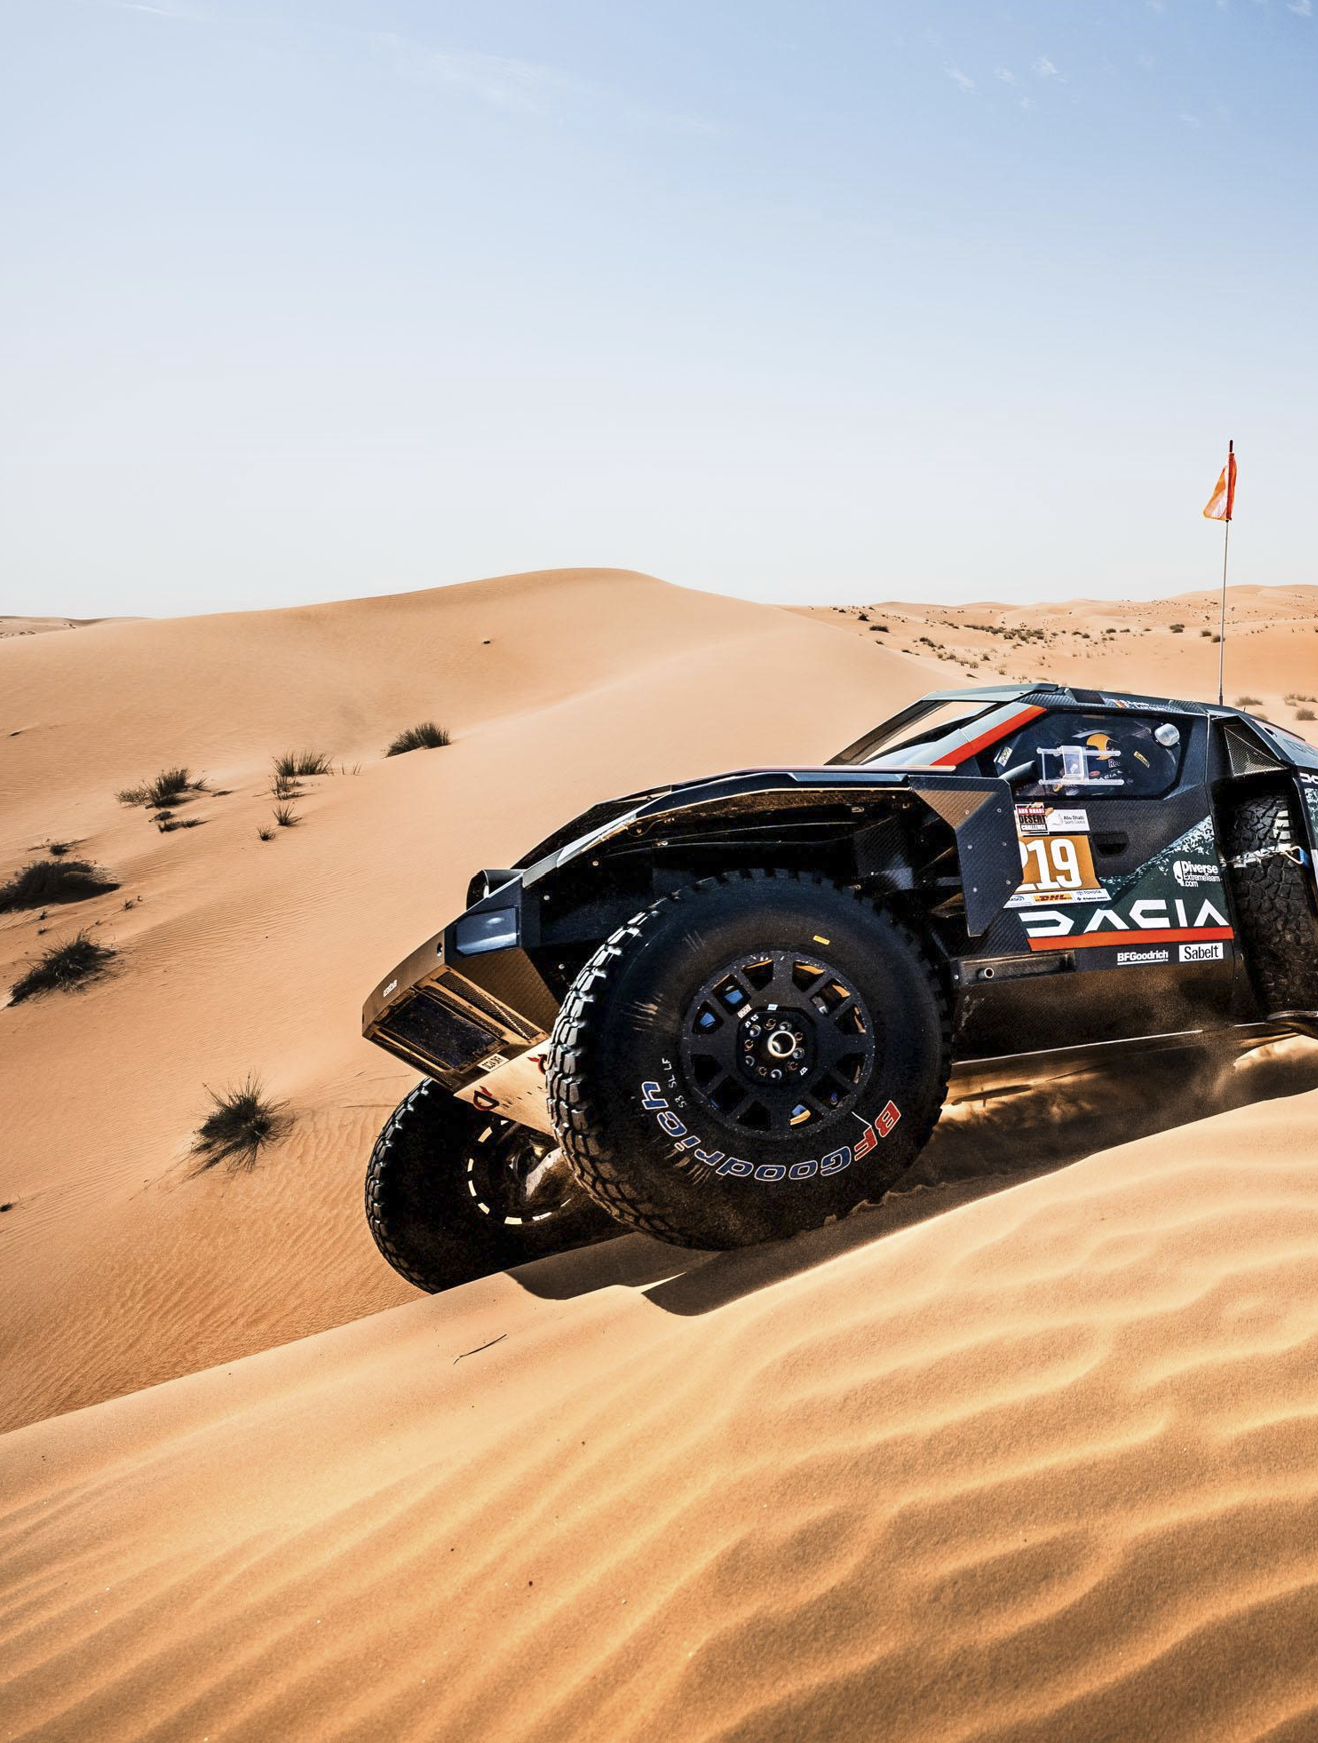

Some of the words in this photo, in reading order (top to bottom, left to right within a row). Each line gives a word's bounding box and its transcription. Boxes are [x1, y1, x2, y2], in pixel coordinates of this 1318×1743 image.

[1019, 815, 1046, 825] DESERT
[1181, 860, 1219, 874] Diverse
[1018, 899, 1230, 938] DACIA
[1117, 950, 1169, 962] BFGoodrich
[1184, 945, 1219, 960] Sabelt
[641, 1081, 902, 1181] BFGoodrich
